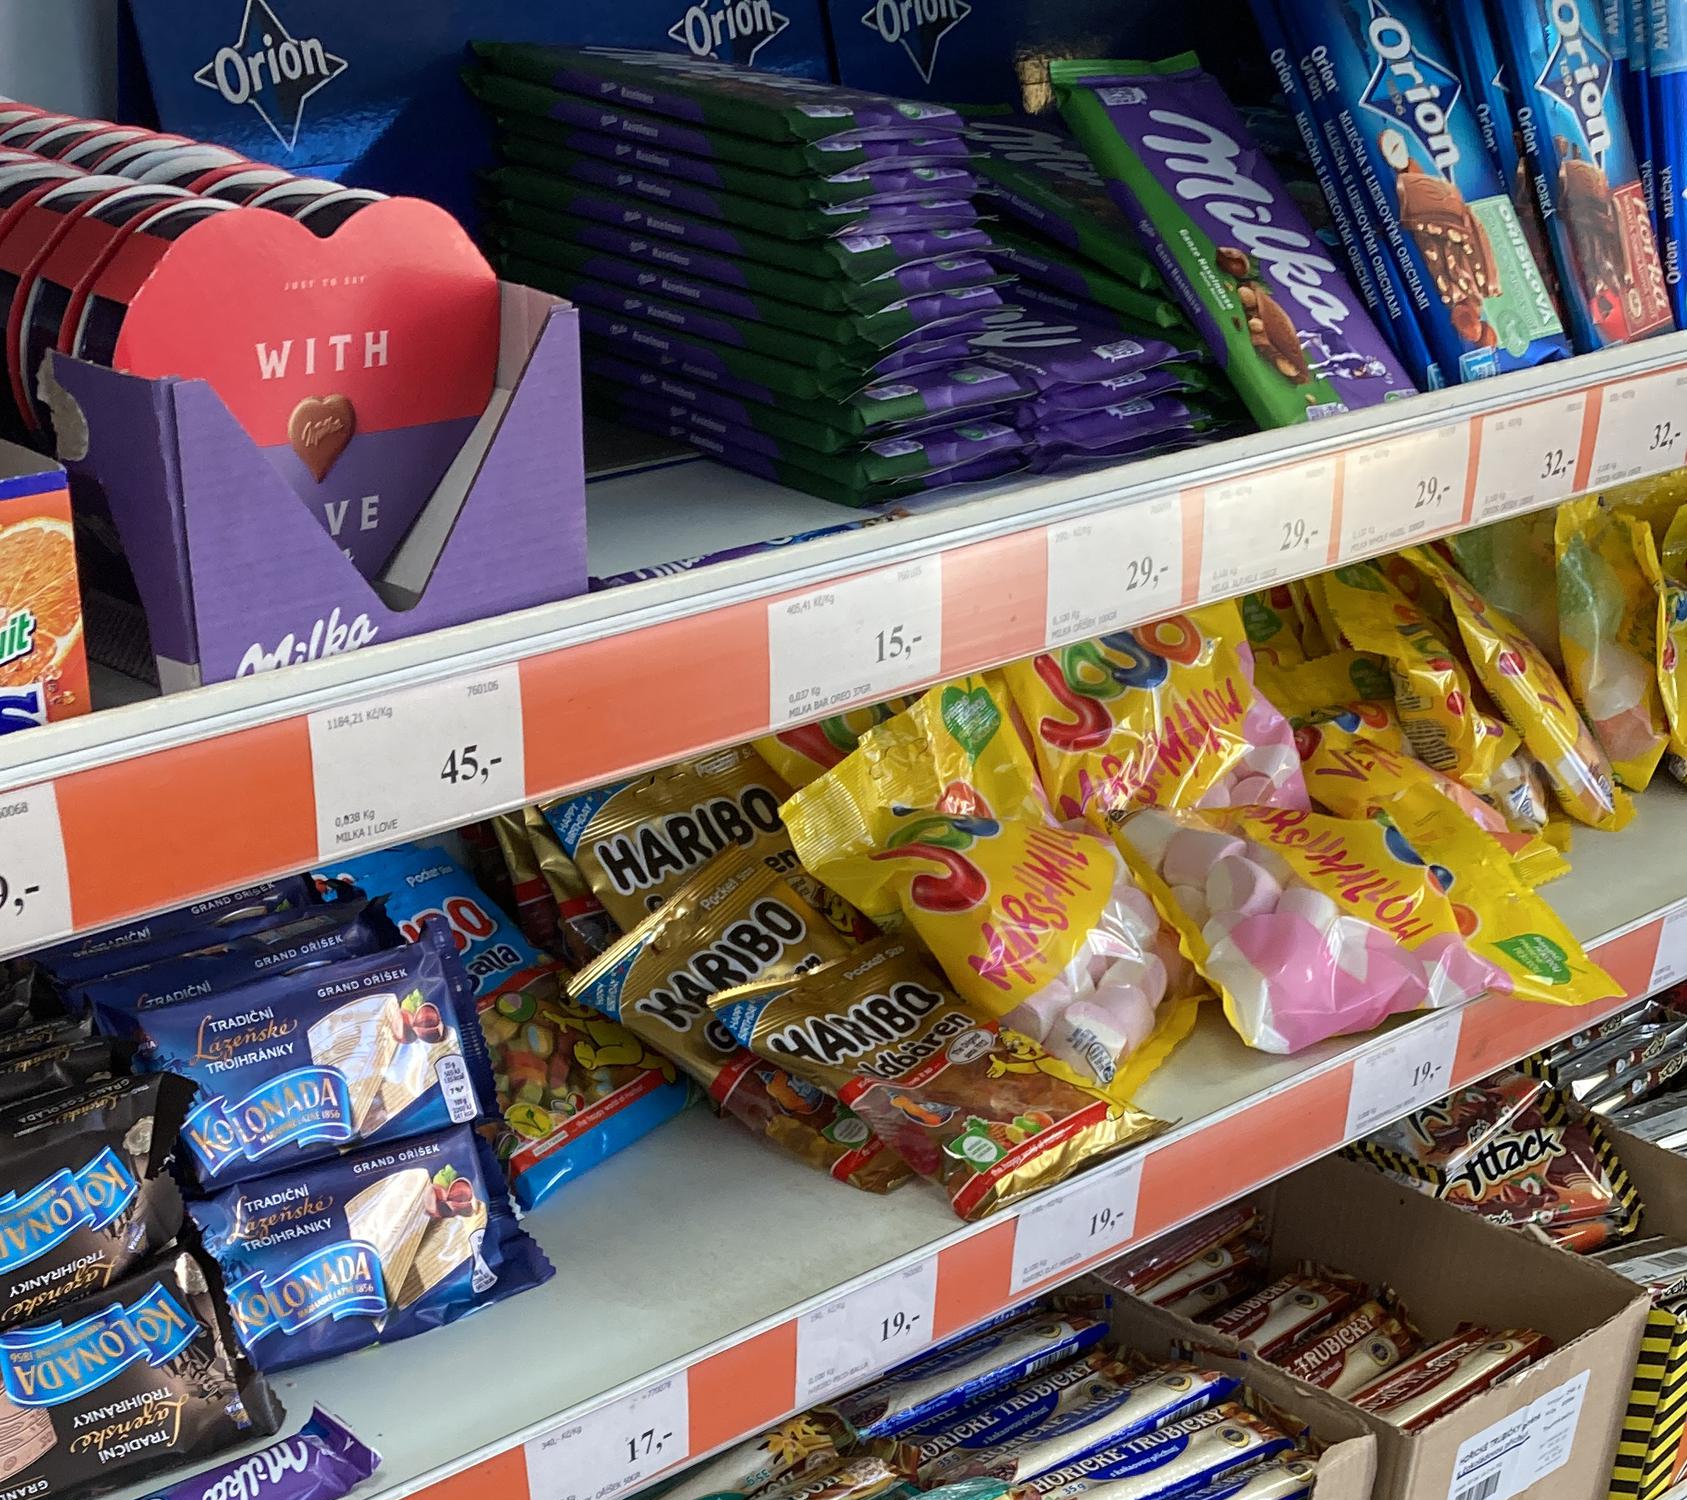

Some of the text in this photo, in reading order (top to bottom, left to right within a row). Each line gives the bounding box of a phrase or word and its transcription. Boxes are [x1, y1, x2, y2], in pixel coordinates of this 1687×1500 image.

[684, 0, 774, 56] Orion
[215, 33, 330, 104] Orion
[1312, 45, 1339, 92] Orion
[1552, 1, 1611, 155] Orion
[1369, 16, 1460, 169] Orion
[1517, 106, 1539, 156] Orion
[1142, 109, 1349, 335] Milka
[255, 329, 390, 380] WITH
[1650, 421, 1681, 451] 32,-
[1541, 449, 1575, 479] 32,-
[1414, 475, 1450, 509] 29,-
[323, 494, 381, 538] VE
[1280, 518, 1319, 552] 29,-
[1126, 556, 1169, 591] 29,-
[875, 624, 922, 664] 15,-
[440, 744, 502, 785] 45,-
[336, 826, 365, 844] MILKA
[374, 819, 399, 834] LOVE
[363, 809, 376, 821] Kg
[595, 784, 785, 895] HARIBO
[191, 896, 231, 916] GRAND
[254, 948, 297, 969] GRAND
[635, 897, 806, 1032] HARIBO
[317, 979, 360, 999] GRAND
[209, 1006, 275, 1034] TRADIČNÍ
[767, 981, 944, 1065] HARIBO
[205, 1043, 294, 1075] TROJHRÁNKY
[857, 1010, 976, 1080] ldbären
[1411, 1061, 1443, 1088] 19,-
[353, 1155, 395, 1174] GRAND
[245, 1184, 309, 1212] TRADIČNÍ
[1088, 1207, 1124, 1238] 19,-
[880, 1311, 921, 1343] 19,-
[98, 1429, 170, 1465] TRADIČNÍ
[627, 1428, 673, 1464] 17,-
[1062, 1484, 1077, 1496] 35
